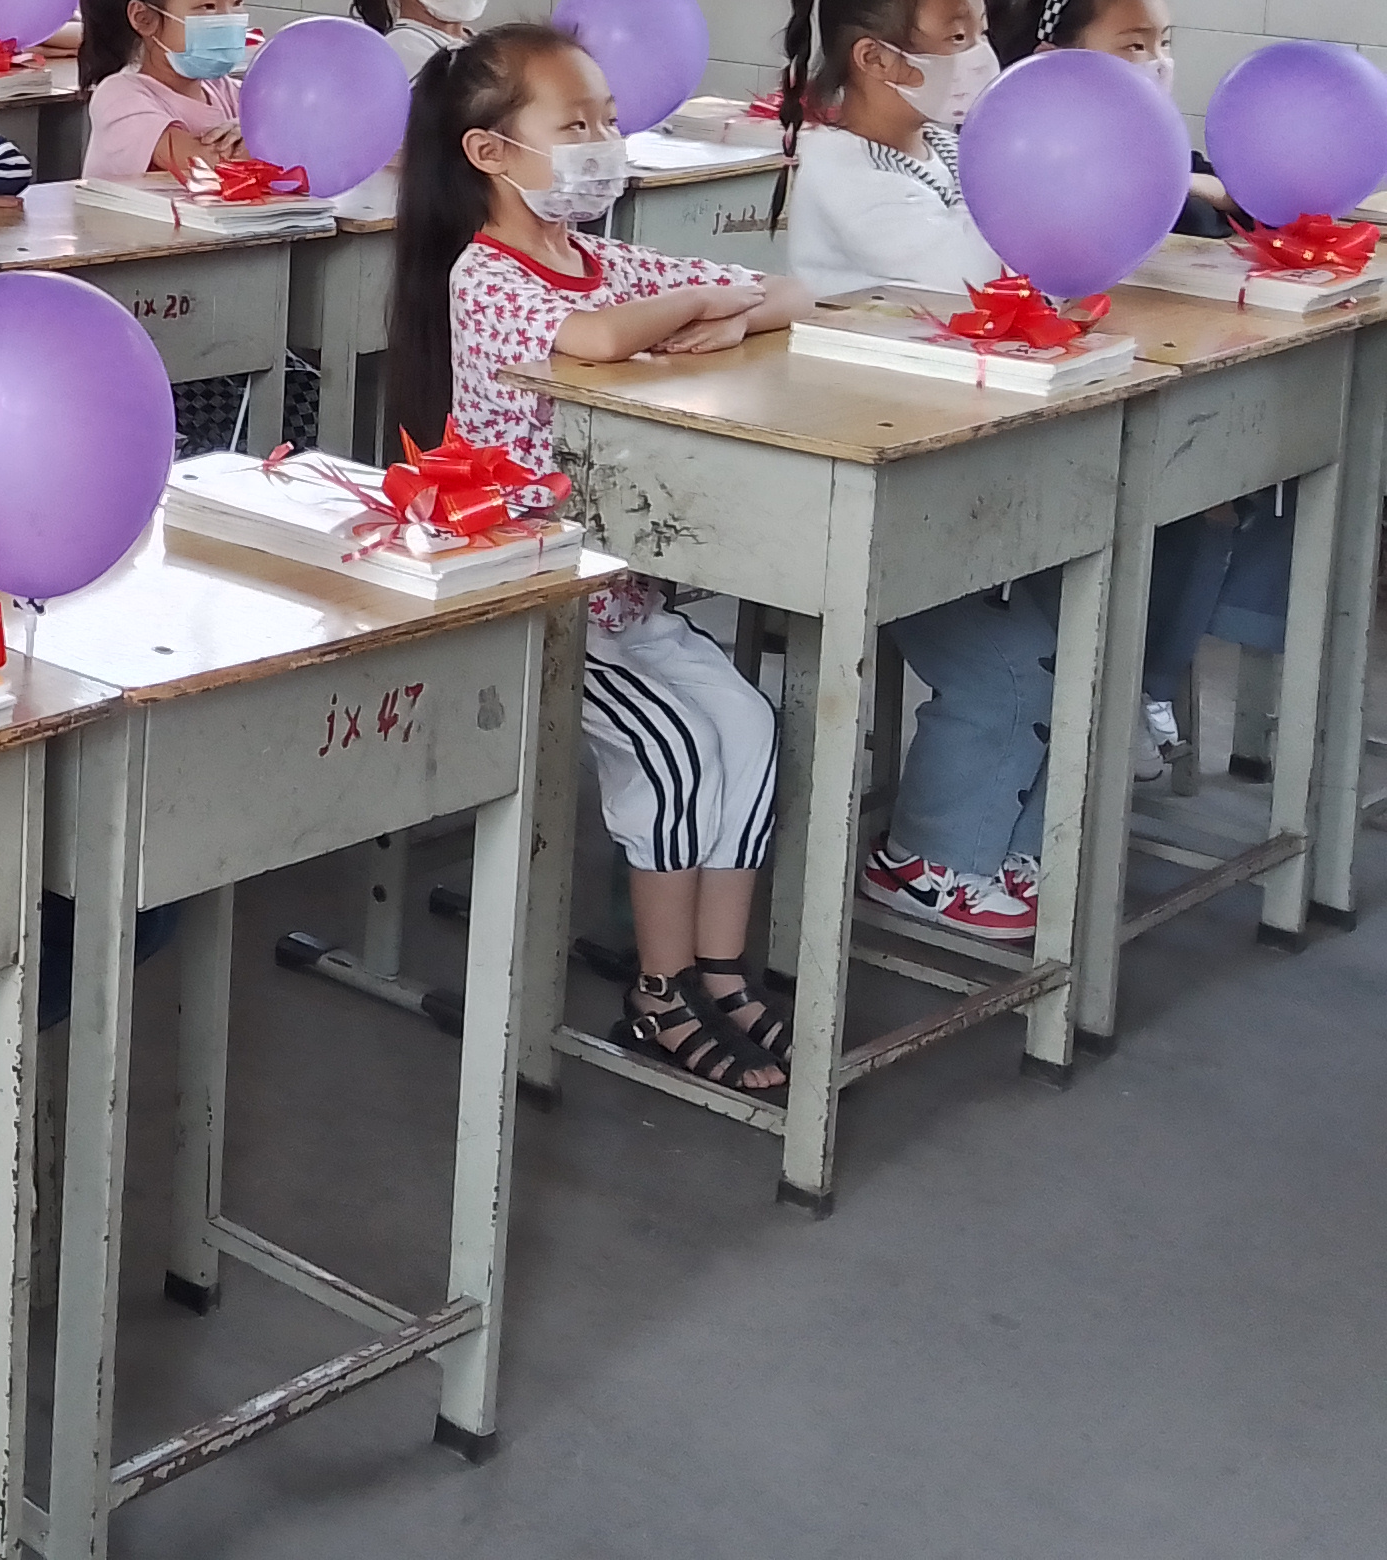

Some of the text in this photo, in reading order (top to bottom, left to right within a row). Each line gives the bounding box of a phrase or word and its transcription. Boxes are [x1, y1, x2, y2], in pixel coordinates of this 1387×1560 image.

[163, 294, 190, 319] 20
[318, 683, 424, 757] jx 47
